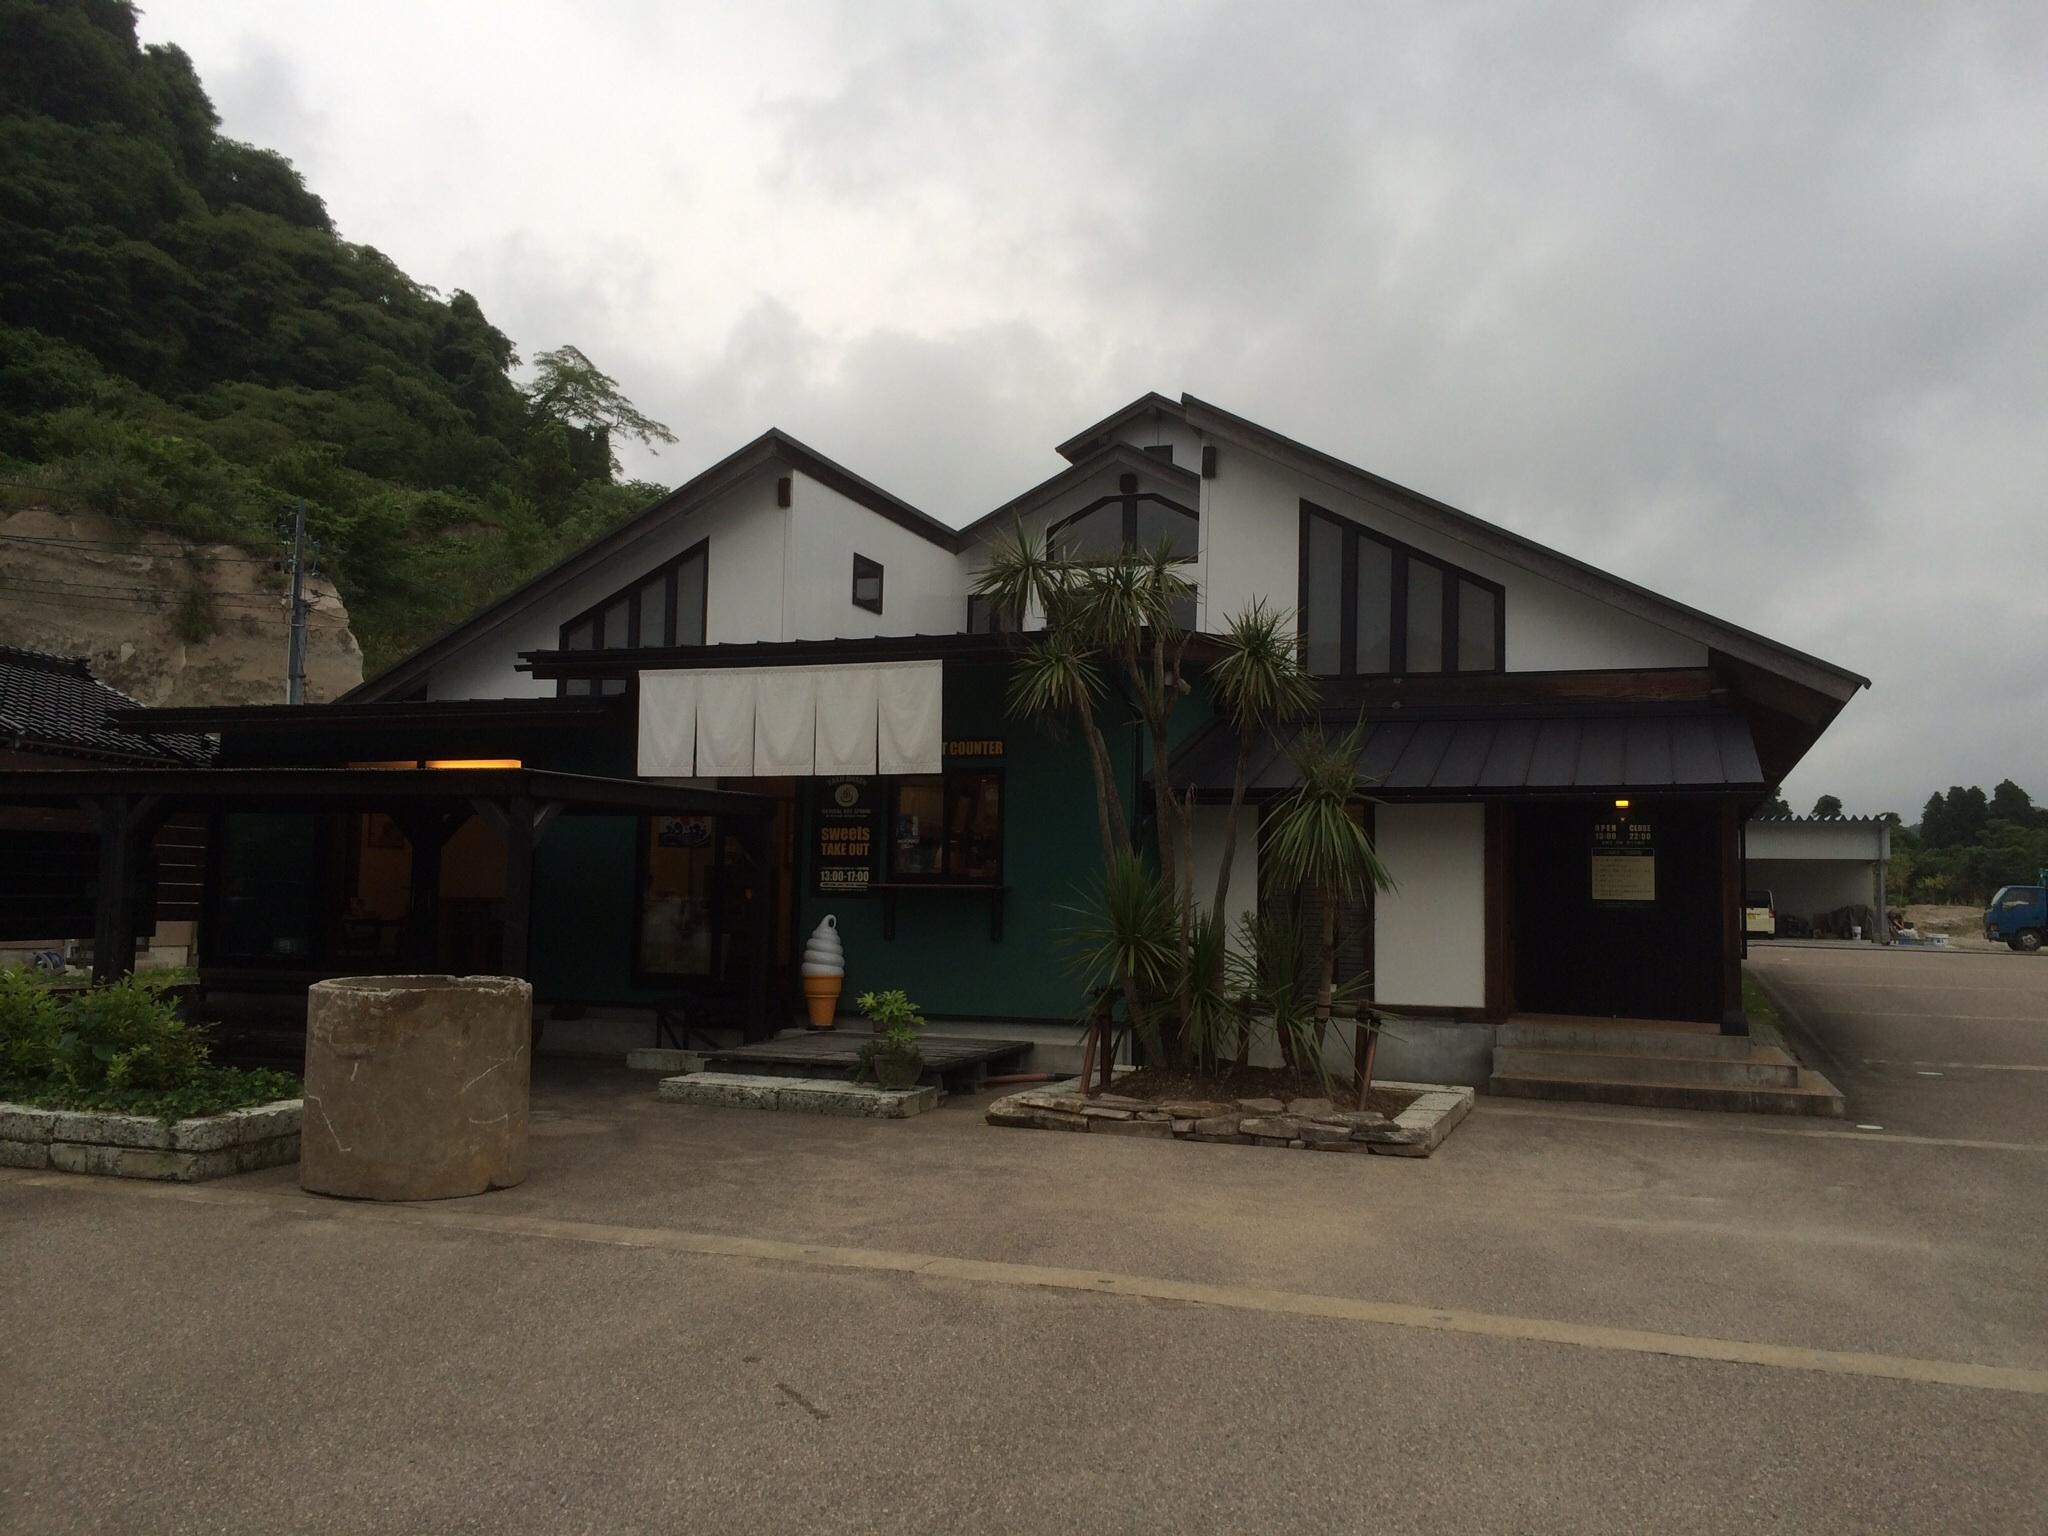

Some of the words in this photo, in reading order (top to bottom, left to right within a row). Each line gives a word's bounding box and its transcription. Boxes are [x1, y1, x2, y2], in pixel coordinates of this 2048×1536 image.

[950, 741, 1003, 755] COUNTER
[821, 825, 870, 841] sweets
[1629, 824, 1651, 832] CLOSE
[821, 842, 847, 856] TAKE
[848, 842, 870, 856] OUT
